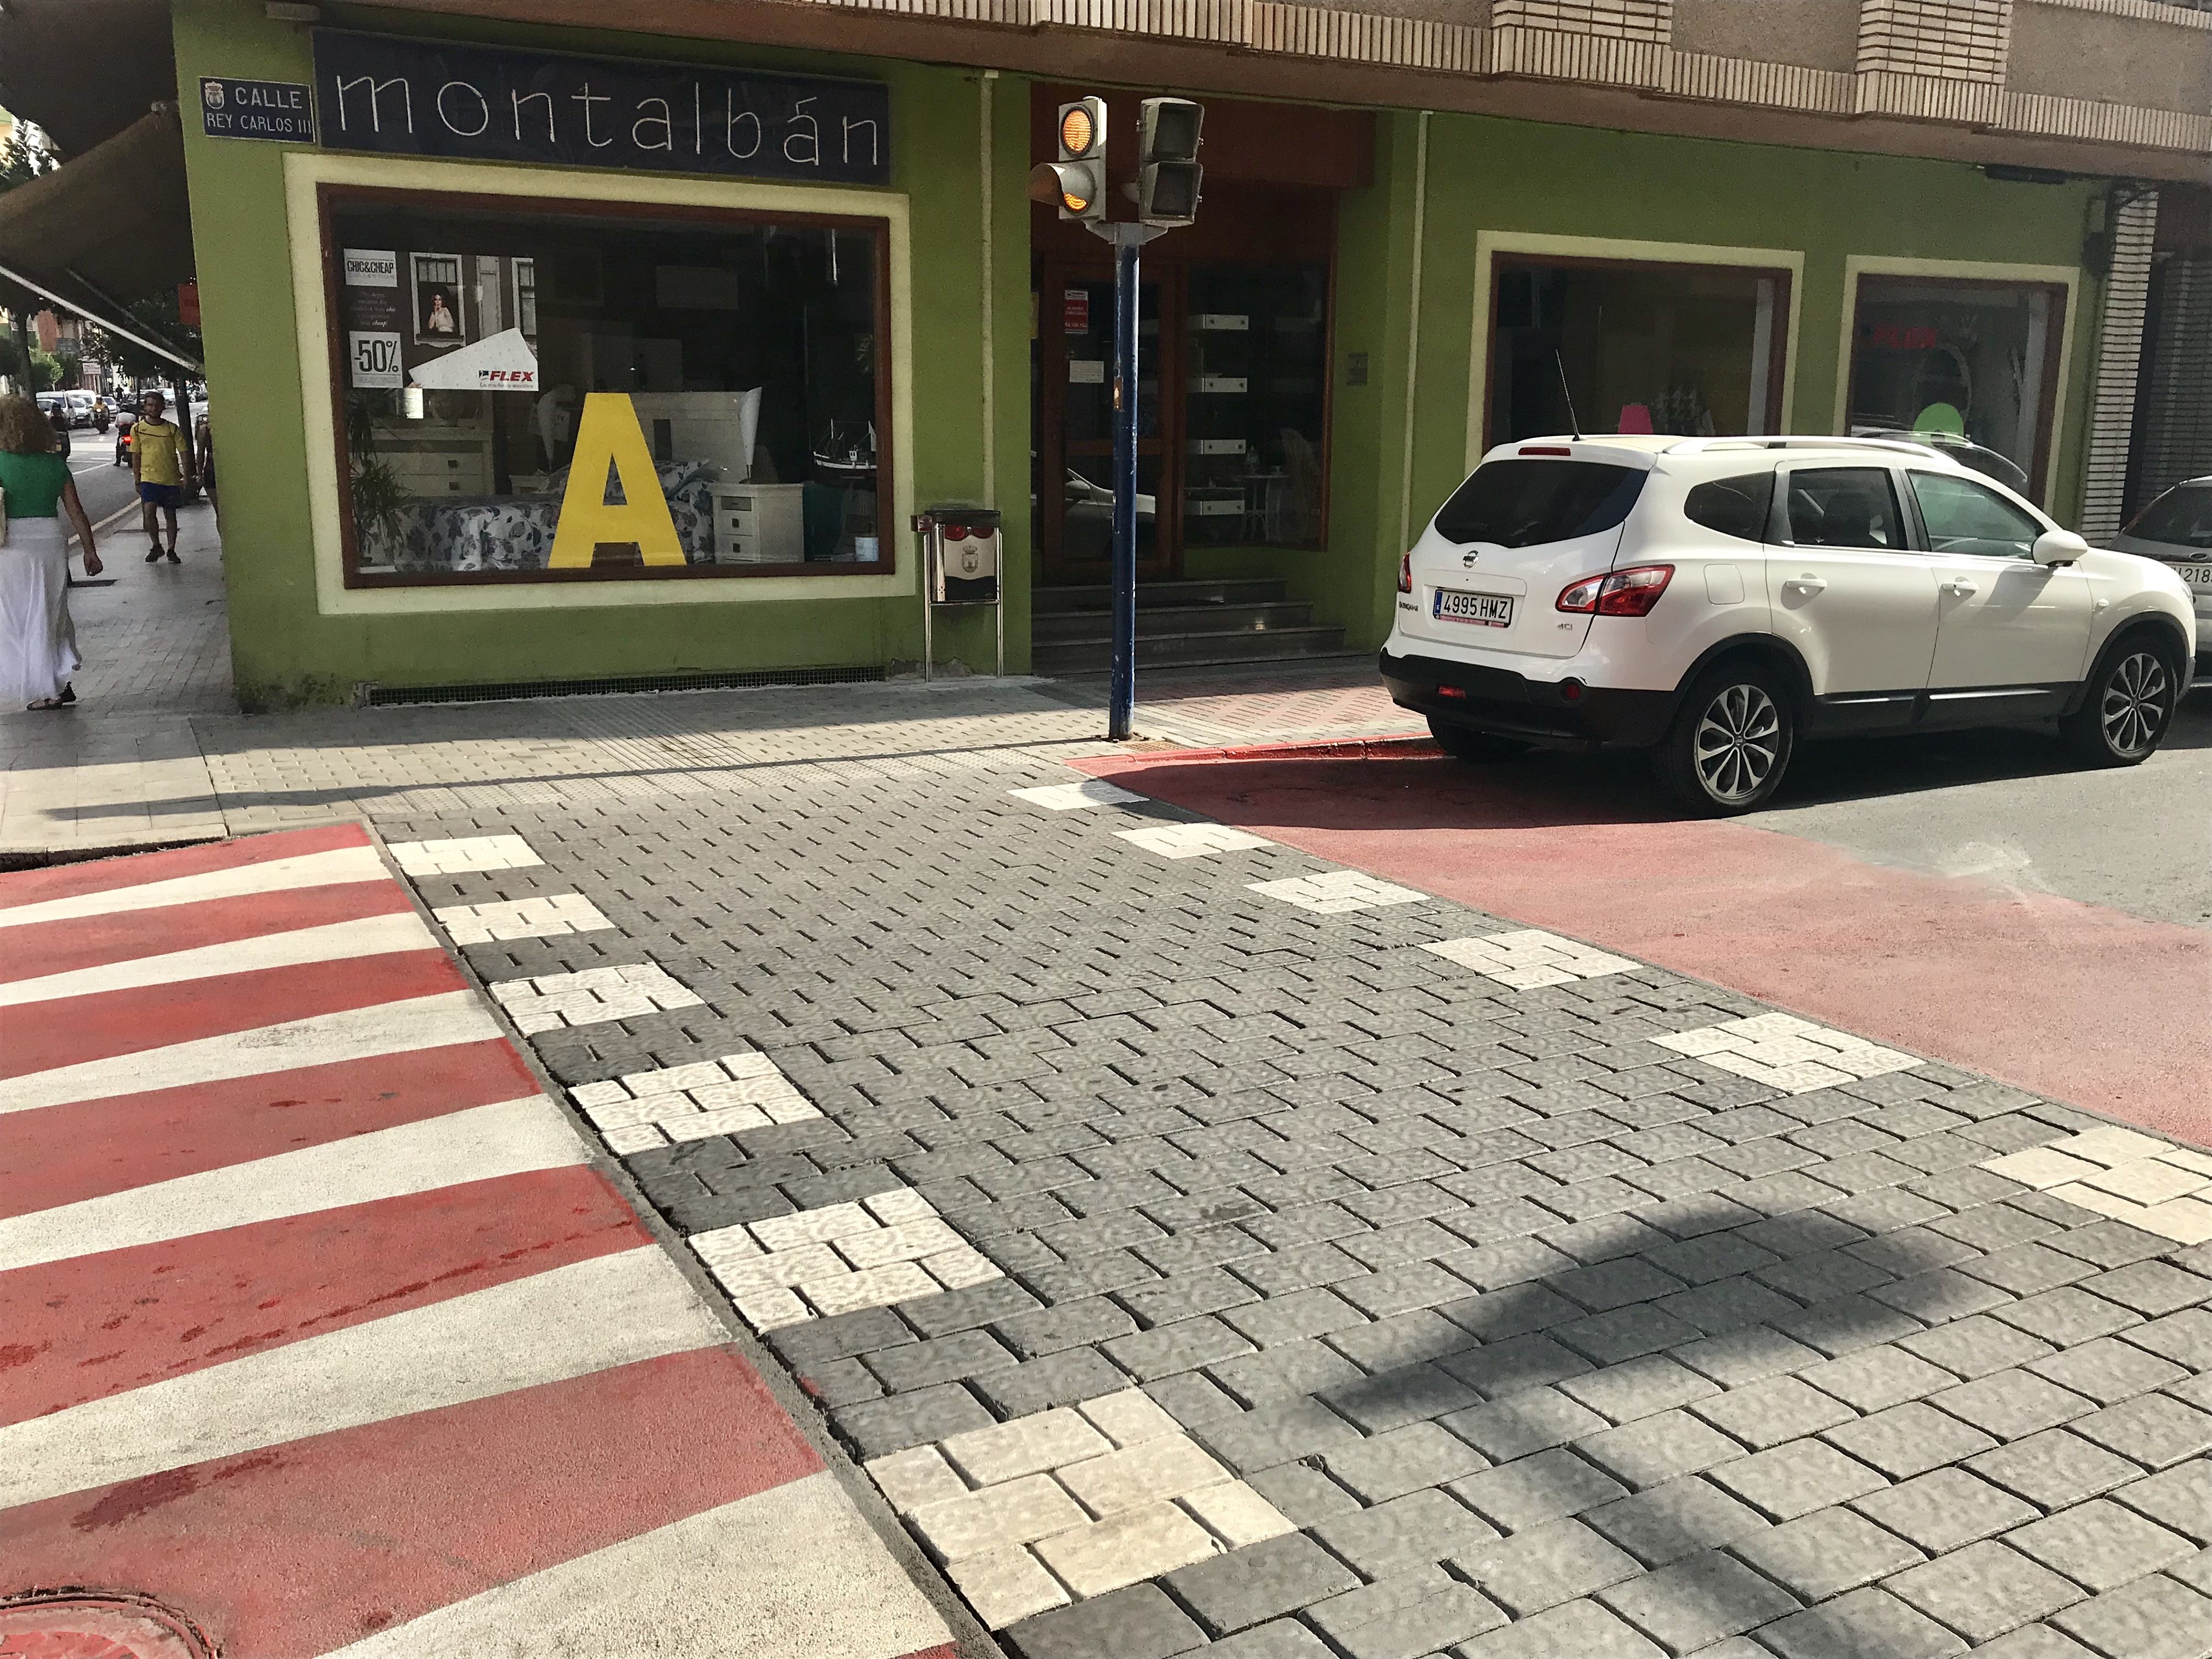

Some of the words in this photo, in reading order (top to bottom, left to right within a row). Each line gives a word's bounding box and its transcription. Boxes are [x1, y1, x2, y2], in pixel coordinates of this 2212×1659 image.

[235, 87, 302, 109] CALLE
[207, 113, 233, 128] REY
[240, 115, 292, 133] CARLOS
[298, 119, 311, 134] III
[336, 75, 878, 166] montalbán
[347, 260, 394, 274] CHIC&CHEAP
[489, 370, 534, 382] FLEX
[548, 392, 687, 568] A
[2172, 567, 2212, 584] 218
[1443, 595, 1477, 616] 4995
[1480, 598, 1509, 619] HMZ
